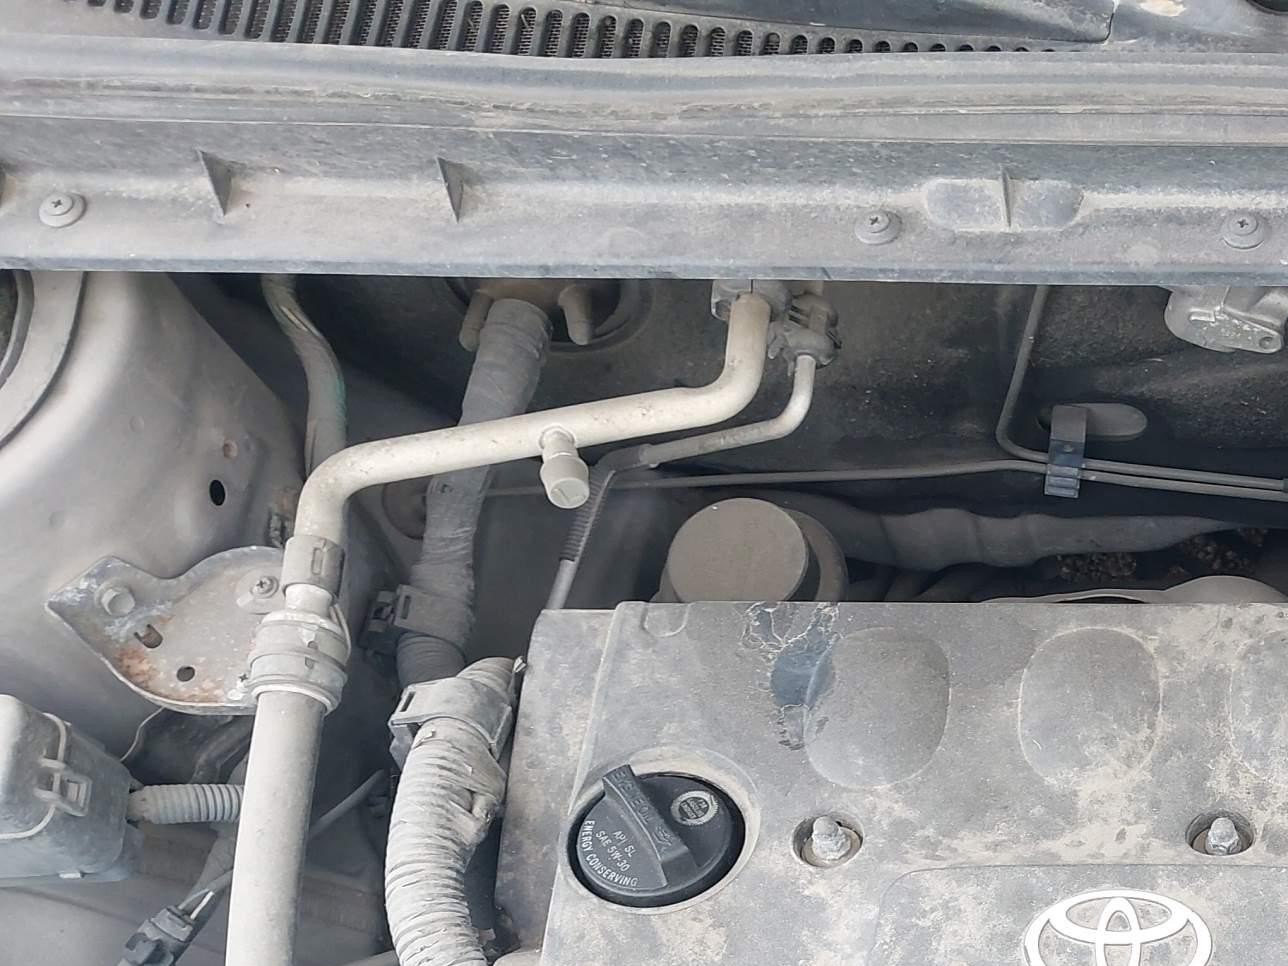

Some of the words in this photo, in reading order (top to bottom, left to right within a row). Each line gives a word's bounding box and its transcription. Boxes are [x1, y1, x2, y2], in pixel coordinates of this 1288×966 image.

[580, 820, 596, 852] ENERGY
[595, 830, 613, 847] SAE
[607, 847, 631, 872] 5W-30
[613, 830, 628, 847] API
[624, 845, 637, 858] SL
[585, 853, 639, 887] CONSERVING
